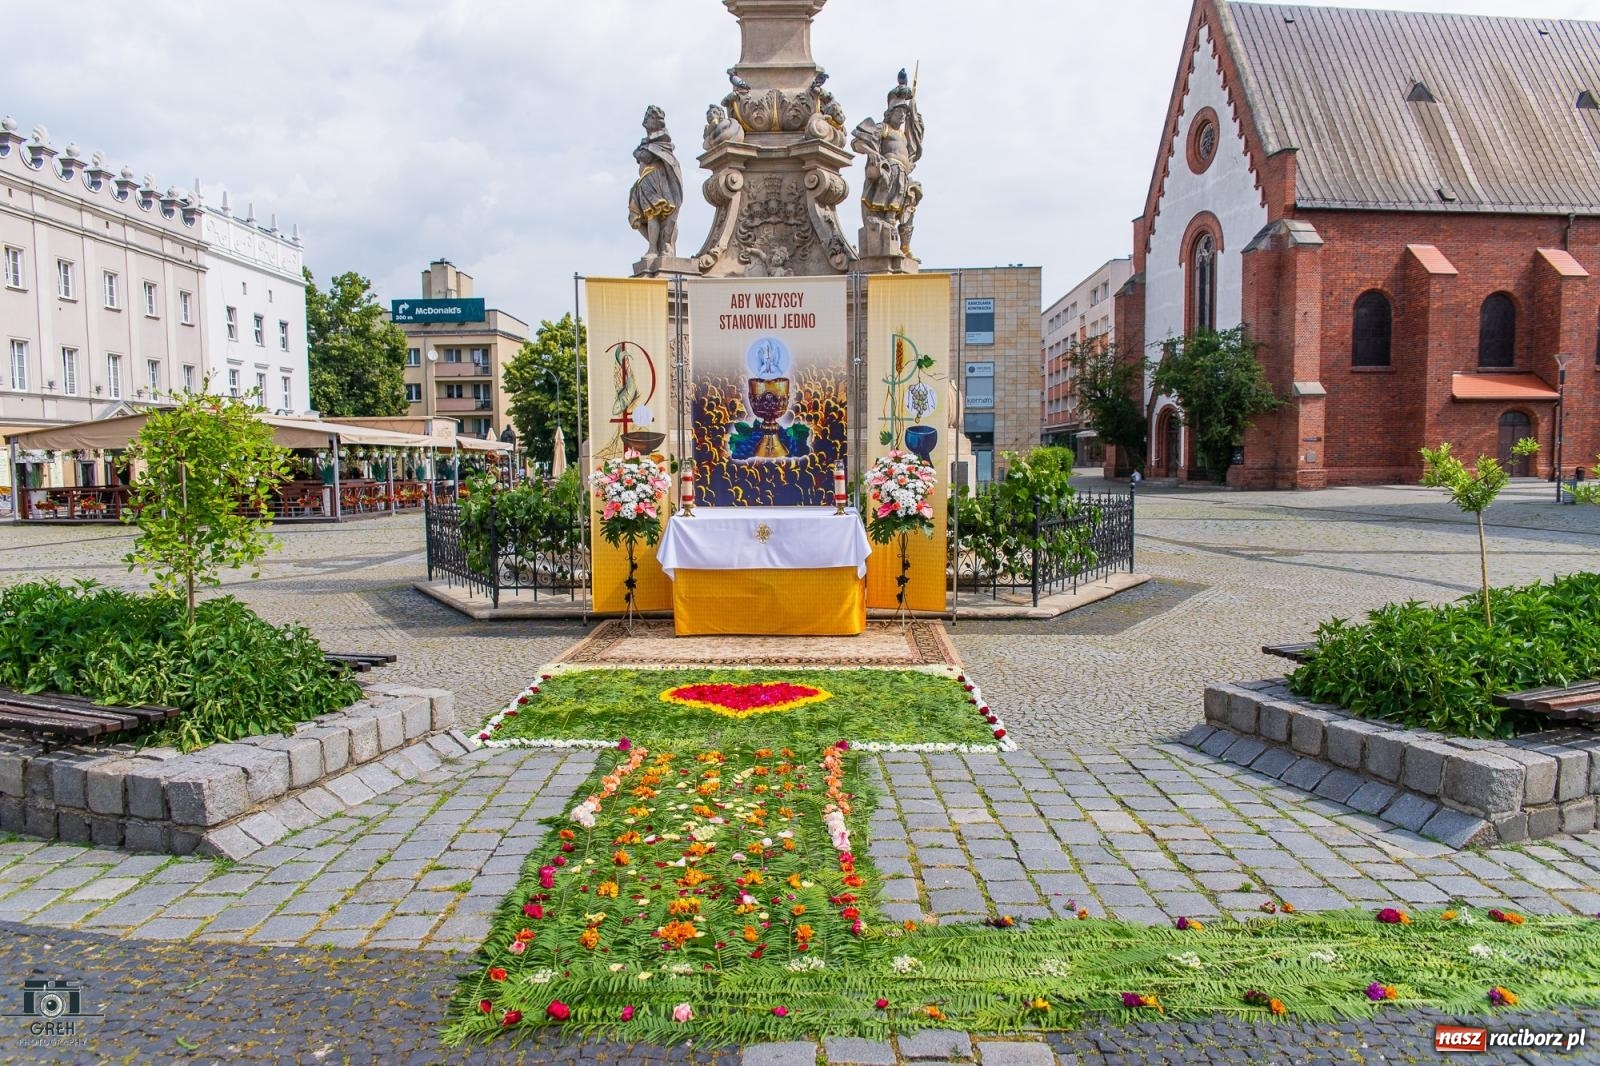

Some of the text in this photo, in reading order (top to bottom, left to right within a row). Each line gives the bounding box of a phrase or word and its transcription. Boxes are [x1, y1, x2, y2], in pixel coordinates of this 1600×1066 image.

[730, 292, 804, 309] ABY WSZYSCY
[415, 306, 462, 315] McDonald's
[719, 312, 816, 330] STANOWILI JEDNO
